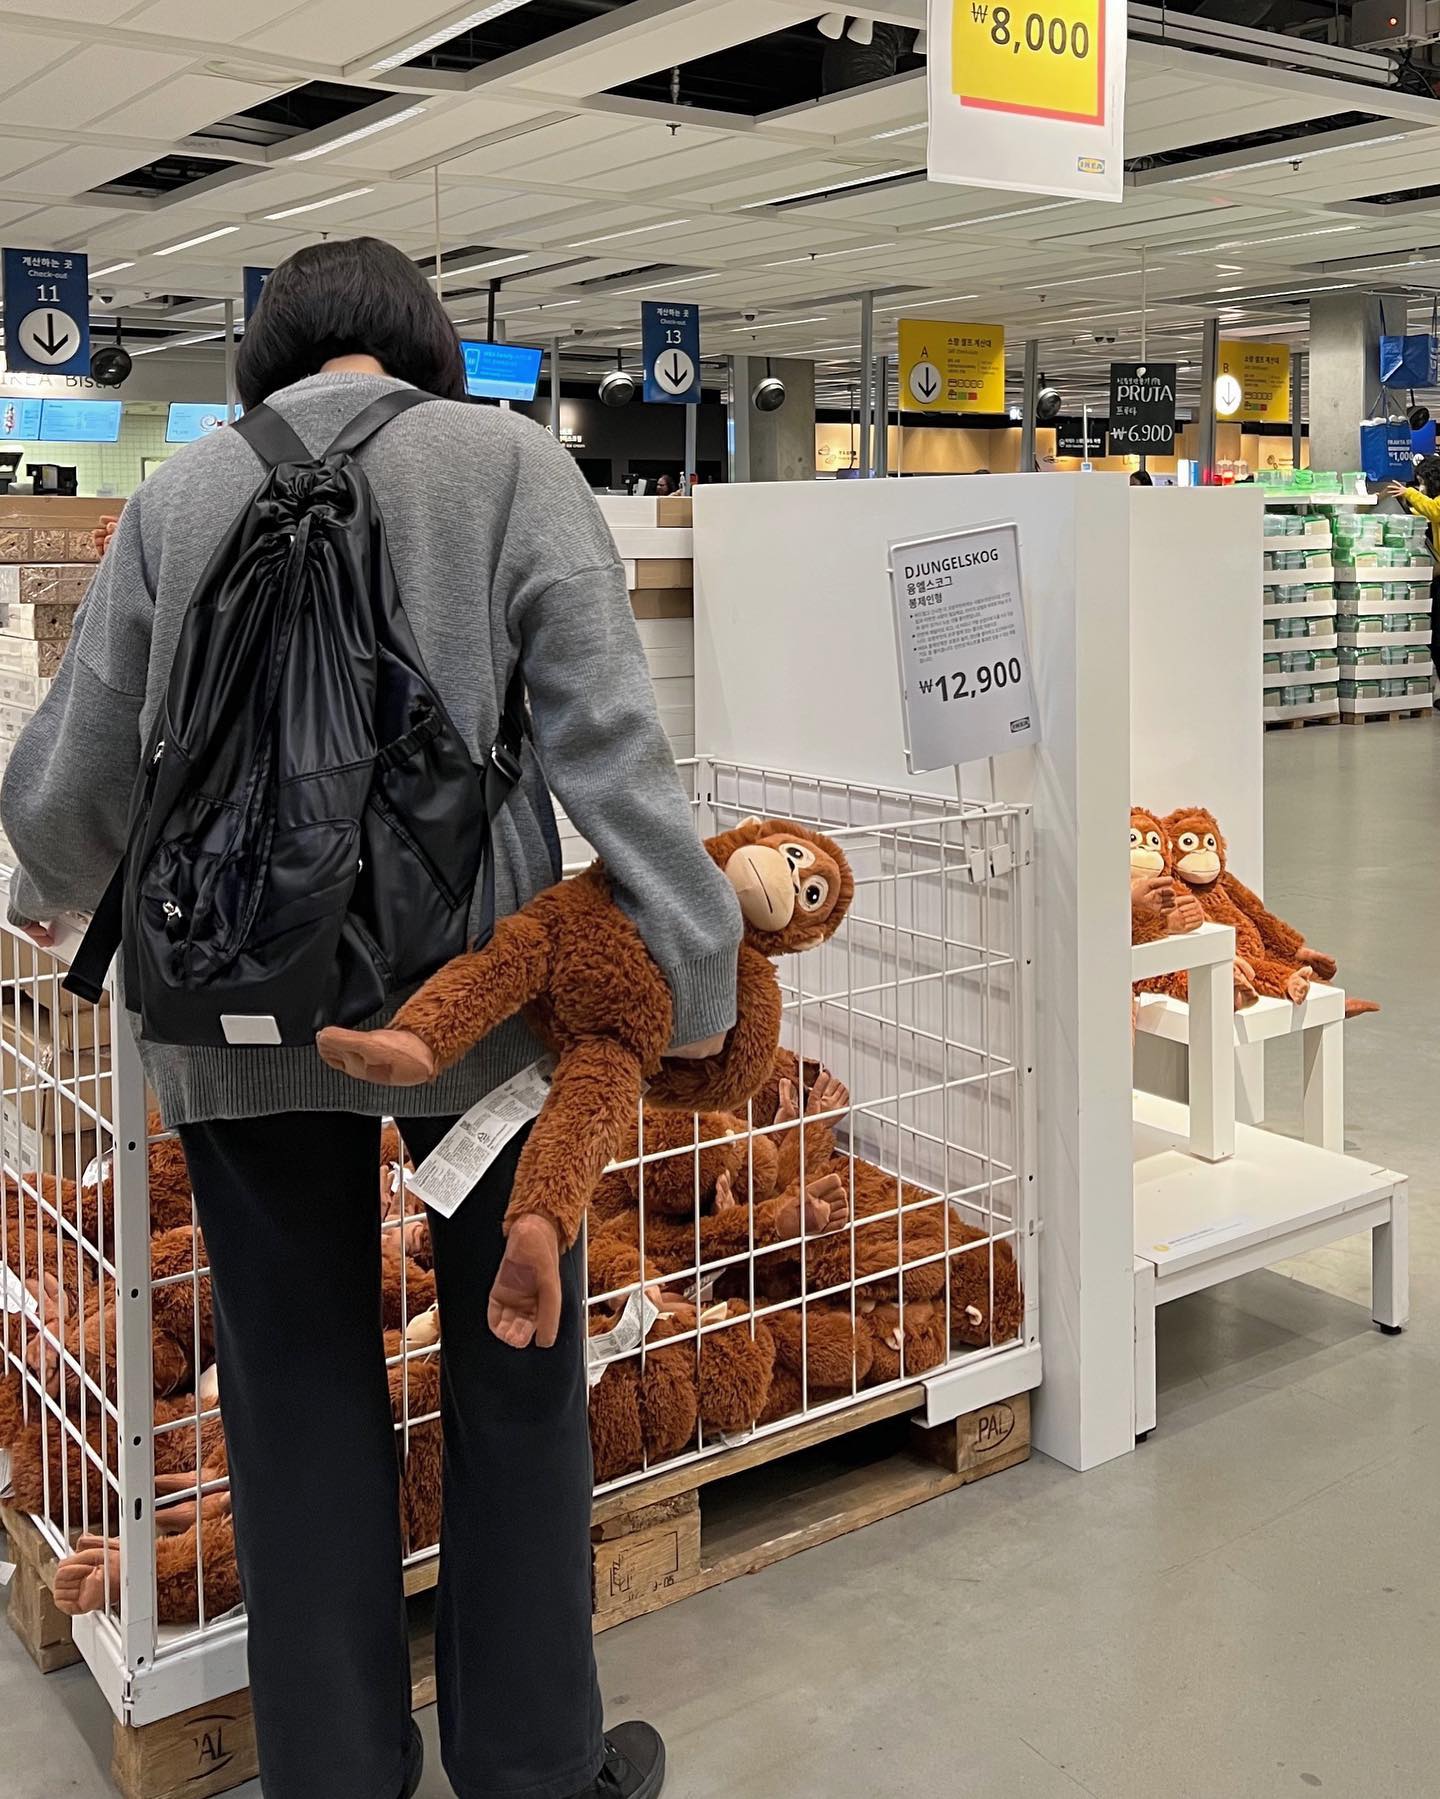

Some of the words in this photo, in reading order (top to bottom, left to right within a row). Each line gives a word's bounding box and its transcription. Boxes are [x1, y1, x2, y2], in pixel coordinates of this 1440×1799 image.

[971, 2, 1089, 58] ₩8,000
[1080, 159, 1104, 172] IKEA
[22, 256, 60, 269] 계산하는
[64, 260, 73, 270] 곳
[27, 269, 68, 279] Check-out
[37, 284, 60, 302] 11
[665, 329, 682, 344] 13
[920, 345, 929, 358] A
[1223, 362, 1229, 373] B
[1117, 384, 1174, 403] PRUTA
[904, 548, 999, 580] DJUNGELSKOG
[908, 592, 943, 609] 봉제인형
[919, 657, 1022, 702] ₩12,900
[1010, 717, 1030, 732] IKEA
